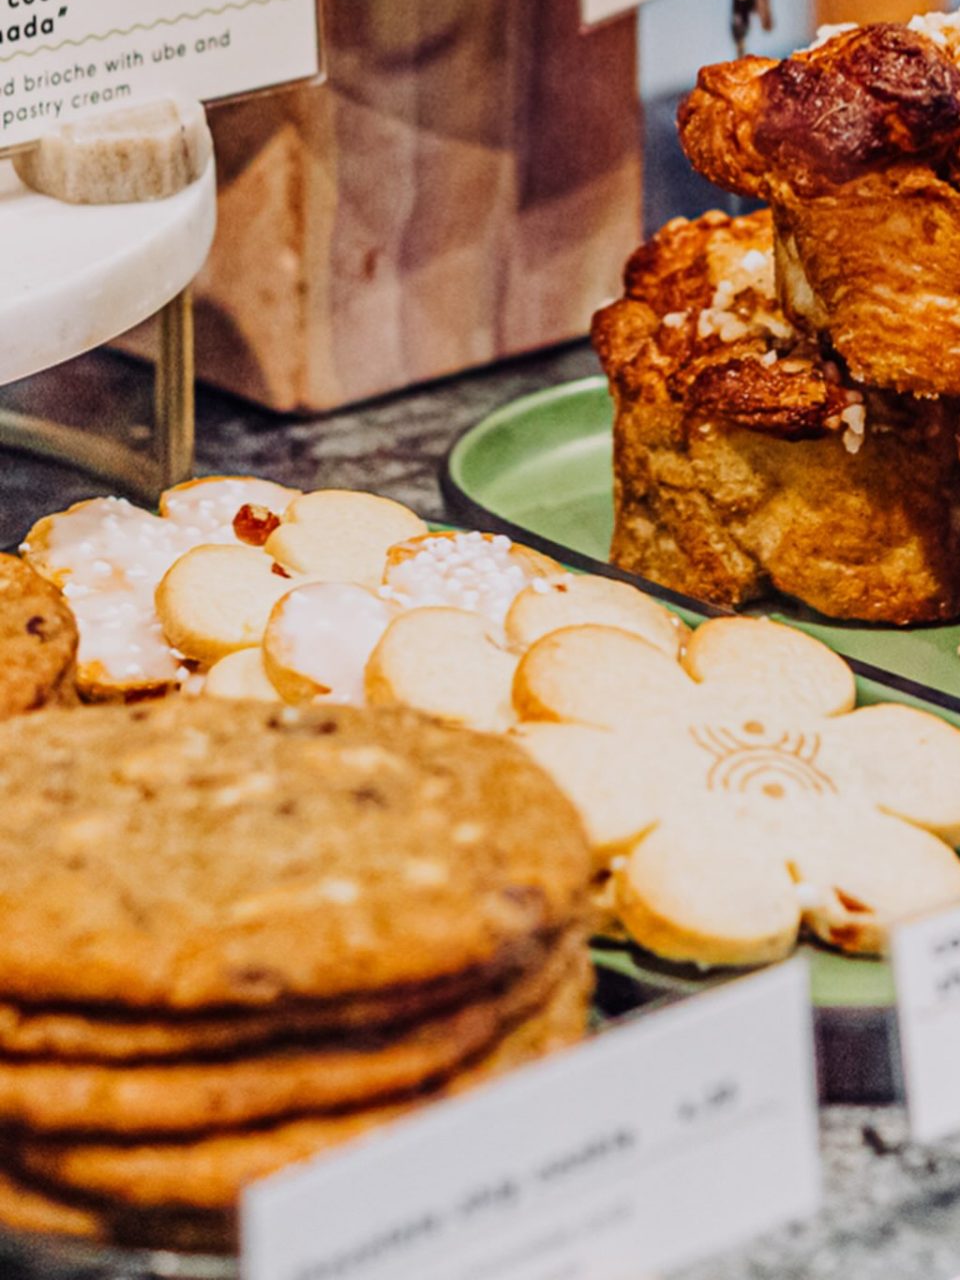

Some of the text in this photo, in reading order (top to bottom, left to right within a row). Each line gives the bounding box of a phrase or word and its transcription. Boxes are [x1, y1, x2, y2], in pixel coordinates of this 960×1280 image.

[24, 63, 97, 92] brioche
[104, 51, 144, 72] with
[152, 42, 187, 63] ube
[195, 29, 231, 54] and
[2, 82, 132, 128] pastry cream
